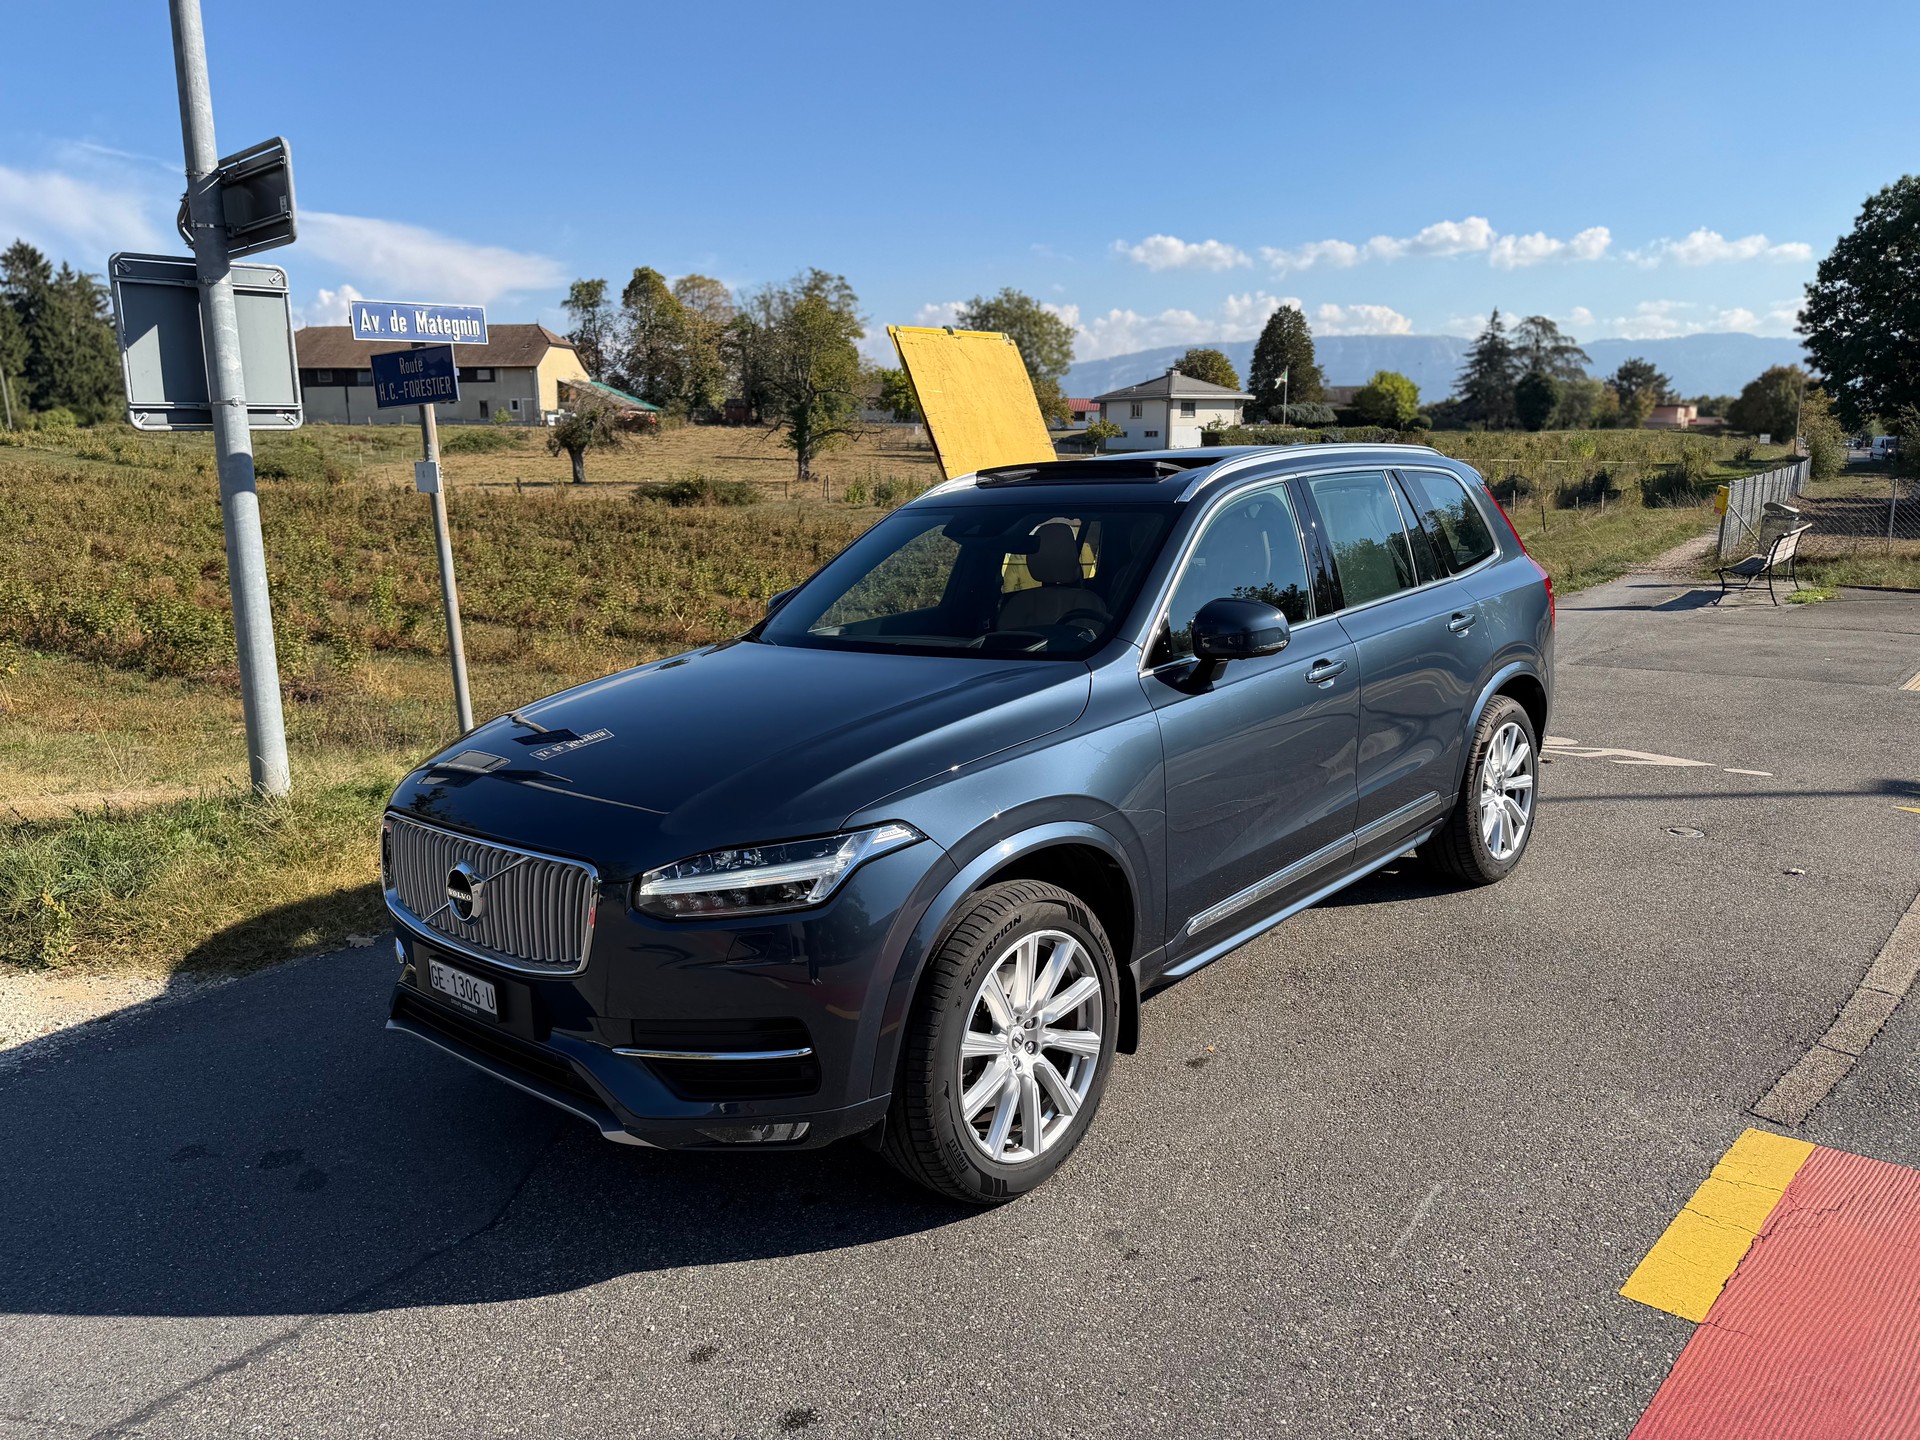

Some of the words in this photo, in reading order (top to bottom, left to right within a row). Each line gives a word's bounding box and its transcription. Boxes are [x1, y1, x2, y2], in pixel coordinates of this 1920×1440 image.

[361, 308, 385, 332] Av.
[390, 309, 407, 332] de
[414, 310, 480, 341] Mategnin
[399, 357, 424, 375] Route
[448, 888, 471, 901] VOLVO
[964, 915, 1022, 990] SCORPION
